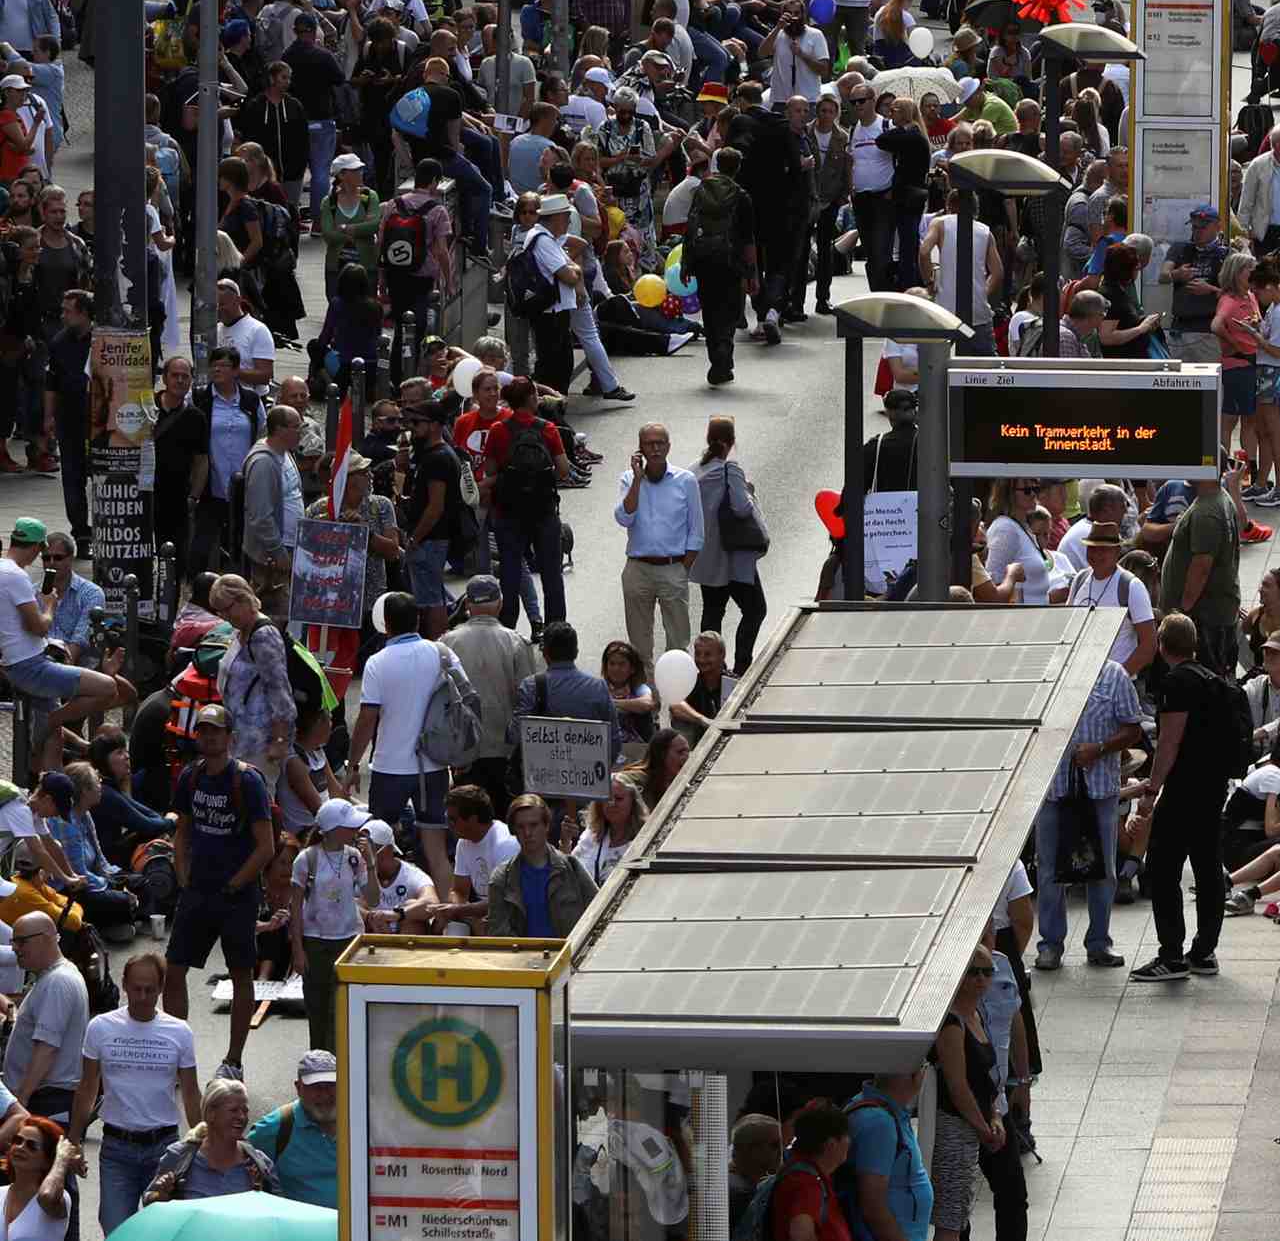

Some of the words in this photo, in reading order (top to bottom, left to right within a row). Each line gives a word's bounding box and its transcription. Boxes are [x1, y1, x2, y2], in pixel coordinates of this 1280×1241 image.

[100, 341, 143, 355] Jenifer
[965, 375, 988, 385] Linie
[996, 375, 1015, 385] Ziel
[1152, 376, 1189, 387] Abfahrt
[1192, 377, 1202, 388] in
[1000, 424, 1029, 438] Kein
[1034, 424, 1111, 439] Tramverkehr
[1116, 425, 1130, 439] in
[1134, 426, 1157, 440] der
[96, 485, 139, 499] RUHIG
[94, 500, 144, 515] BLEIBEN
[96, 527, 142, 543] DILDOS
[526, 726, 560, 744] Selbst
[564, 726, 603, 747] denken
[550, 746, 575, 760] statt
[387, 1164, 408, 1177] M1
[480, 1164, 508, 1177] Nord
[387, 1214, 408, 1227] M1
[421, 1226, 497, 1240] Schillerstraße
